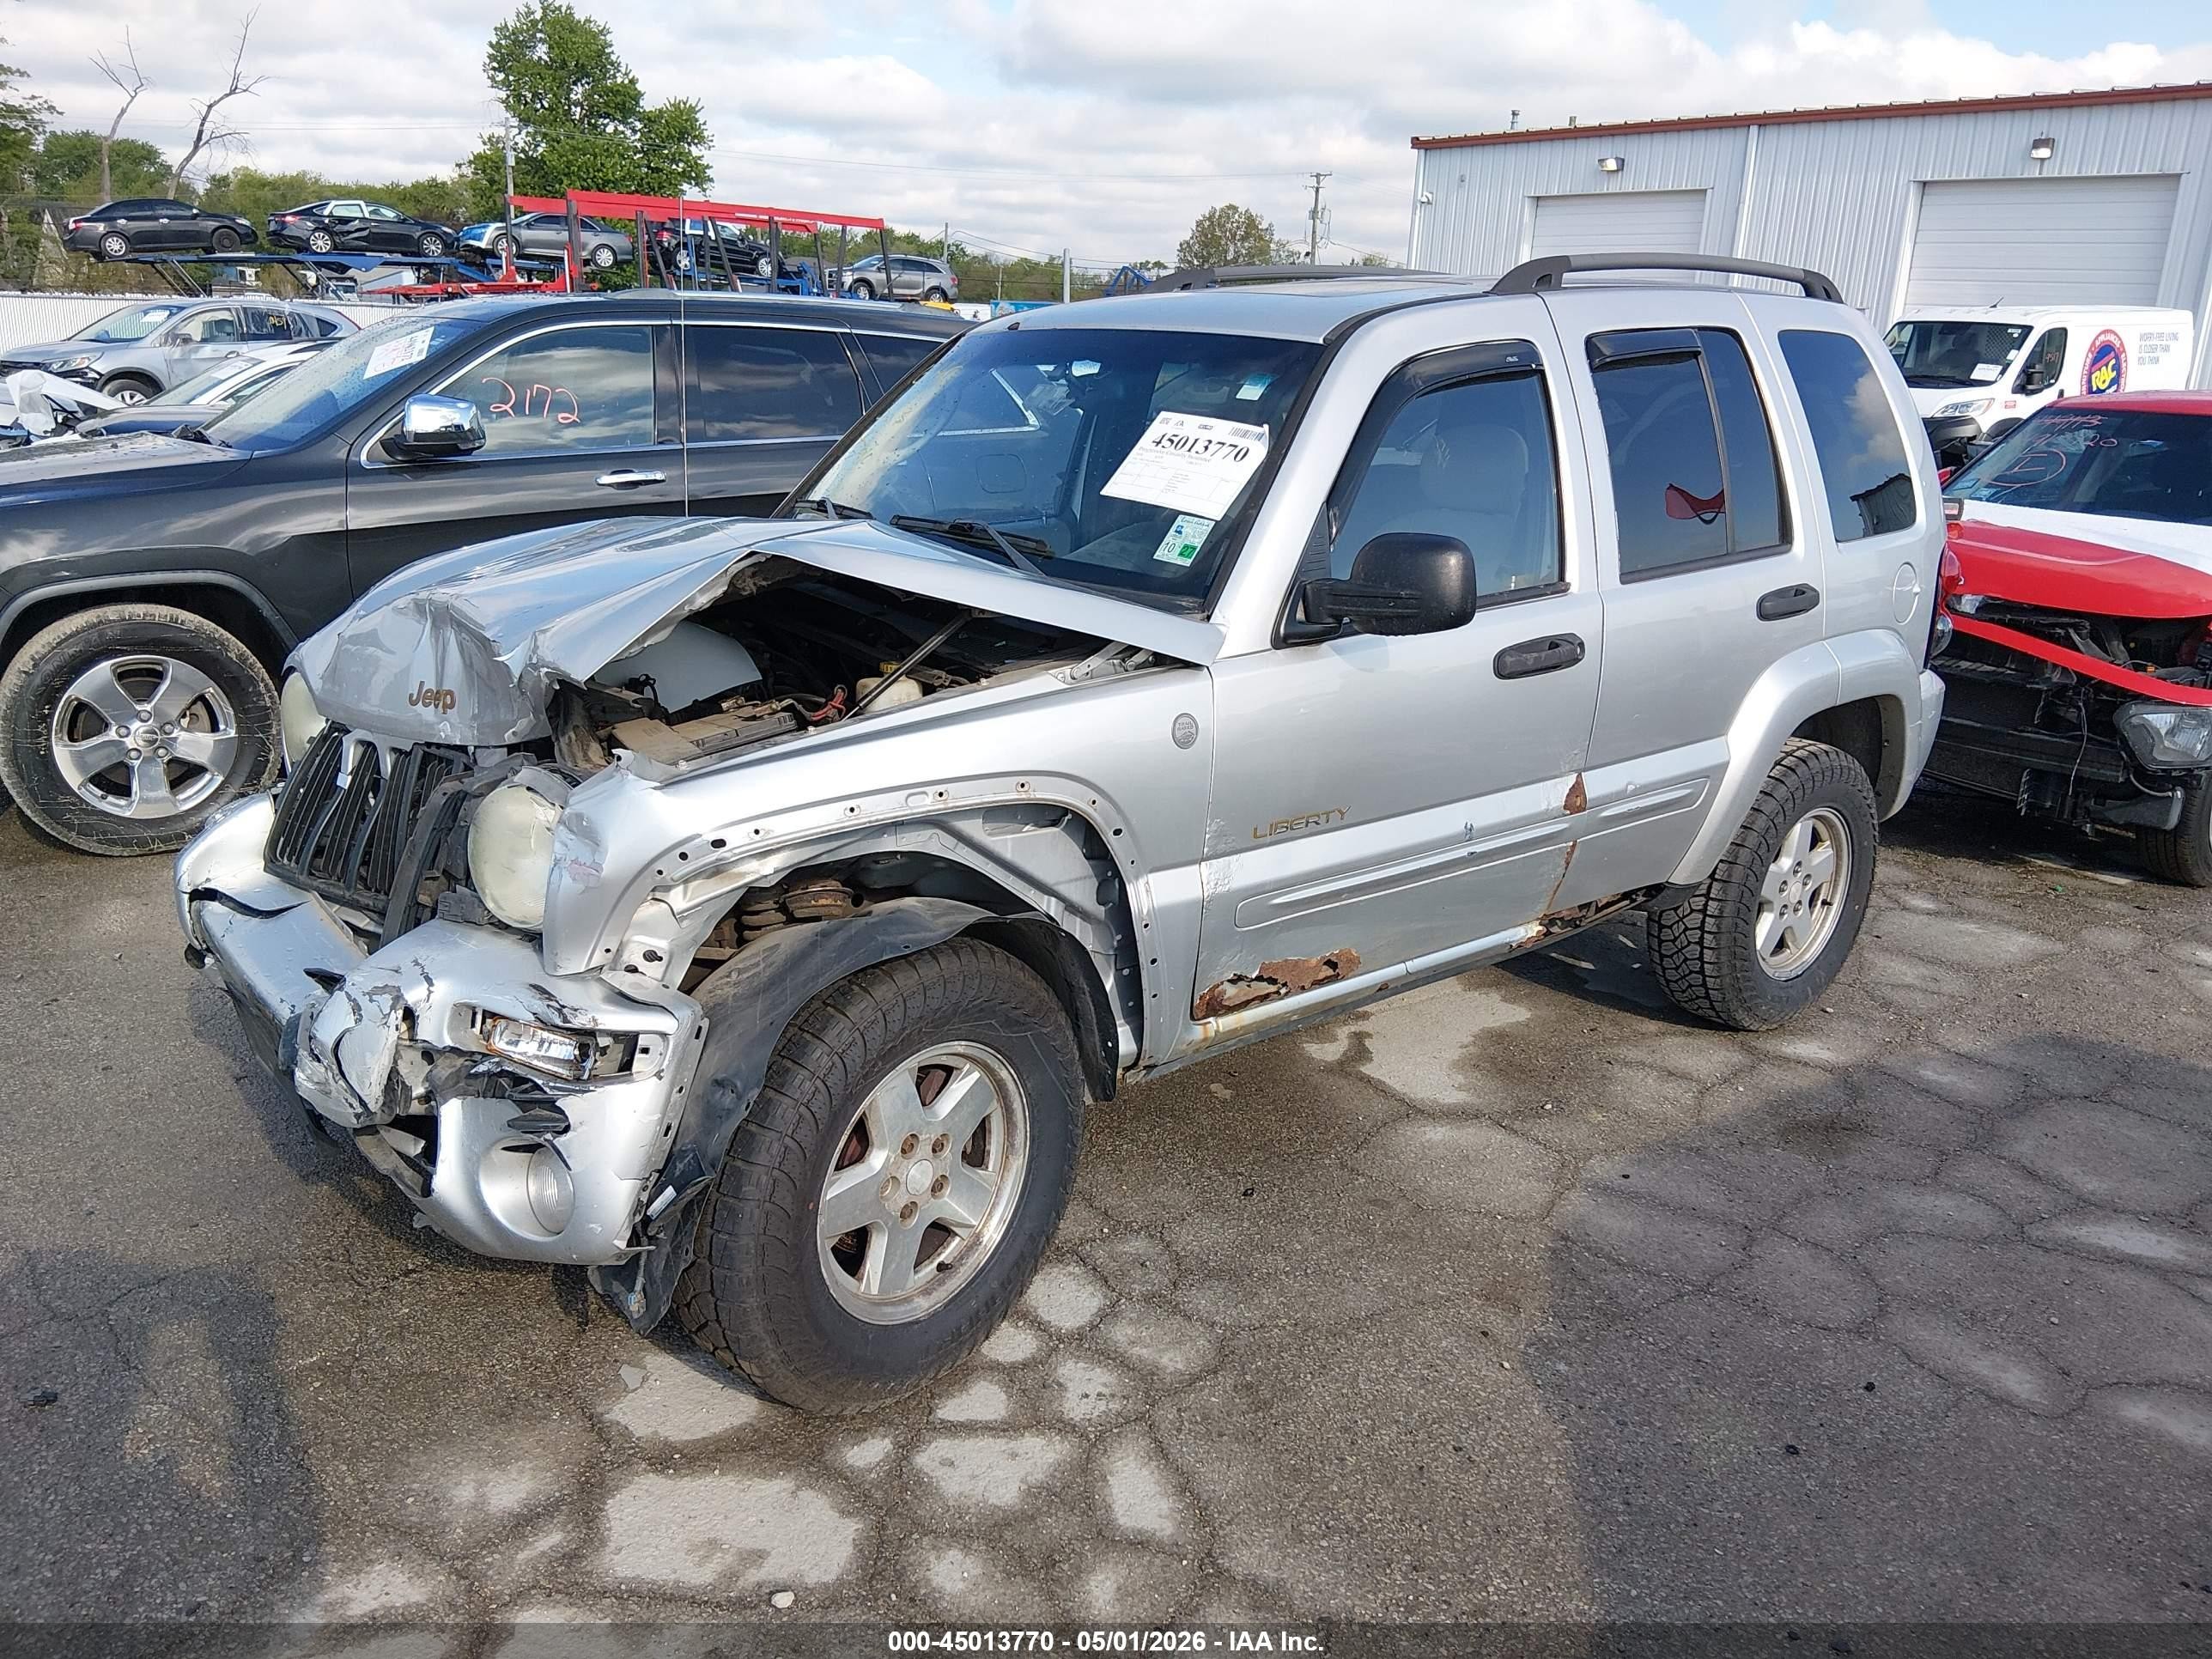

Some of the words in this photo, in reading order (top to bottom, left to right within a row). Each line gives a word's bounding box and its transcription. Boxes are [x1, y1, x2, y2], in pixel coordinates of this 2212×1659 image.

[481, 377, 581, 424] 2172
[1152, 432, 1250, 463] 45013770
[1163, 541, 1176, 554] 10
[1180, 544, 1198, 560] 27
[409, 680, 457, 715] Jeep
[1253, 805, 1352, 840] LIBERTY
